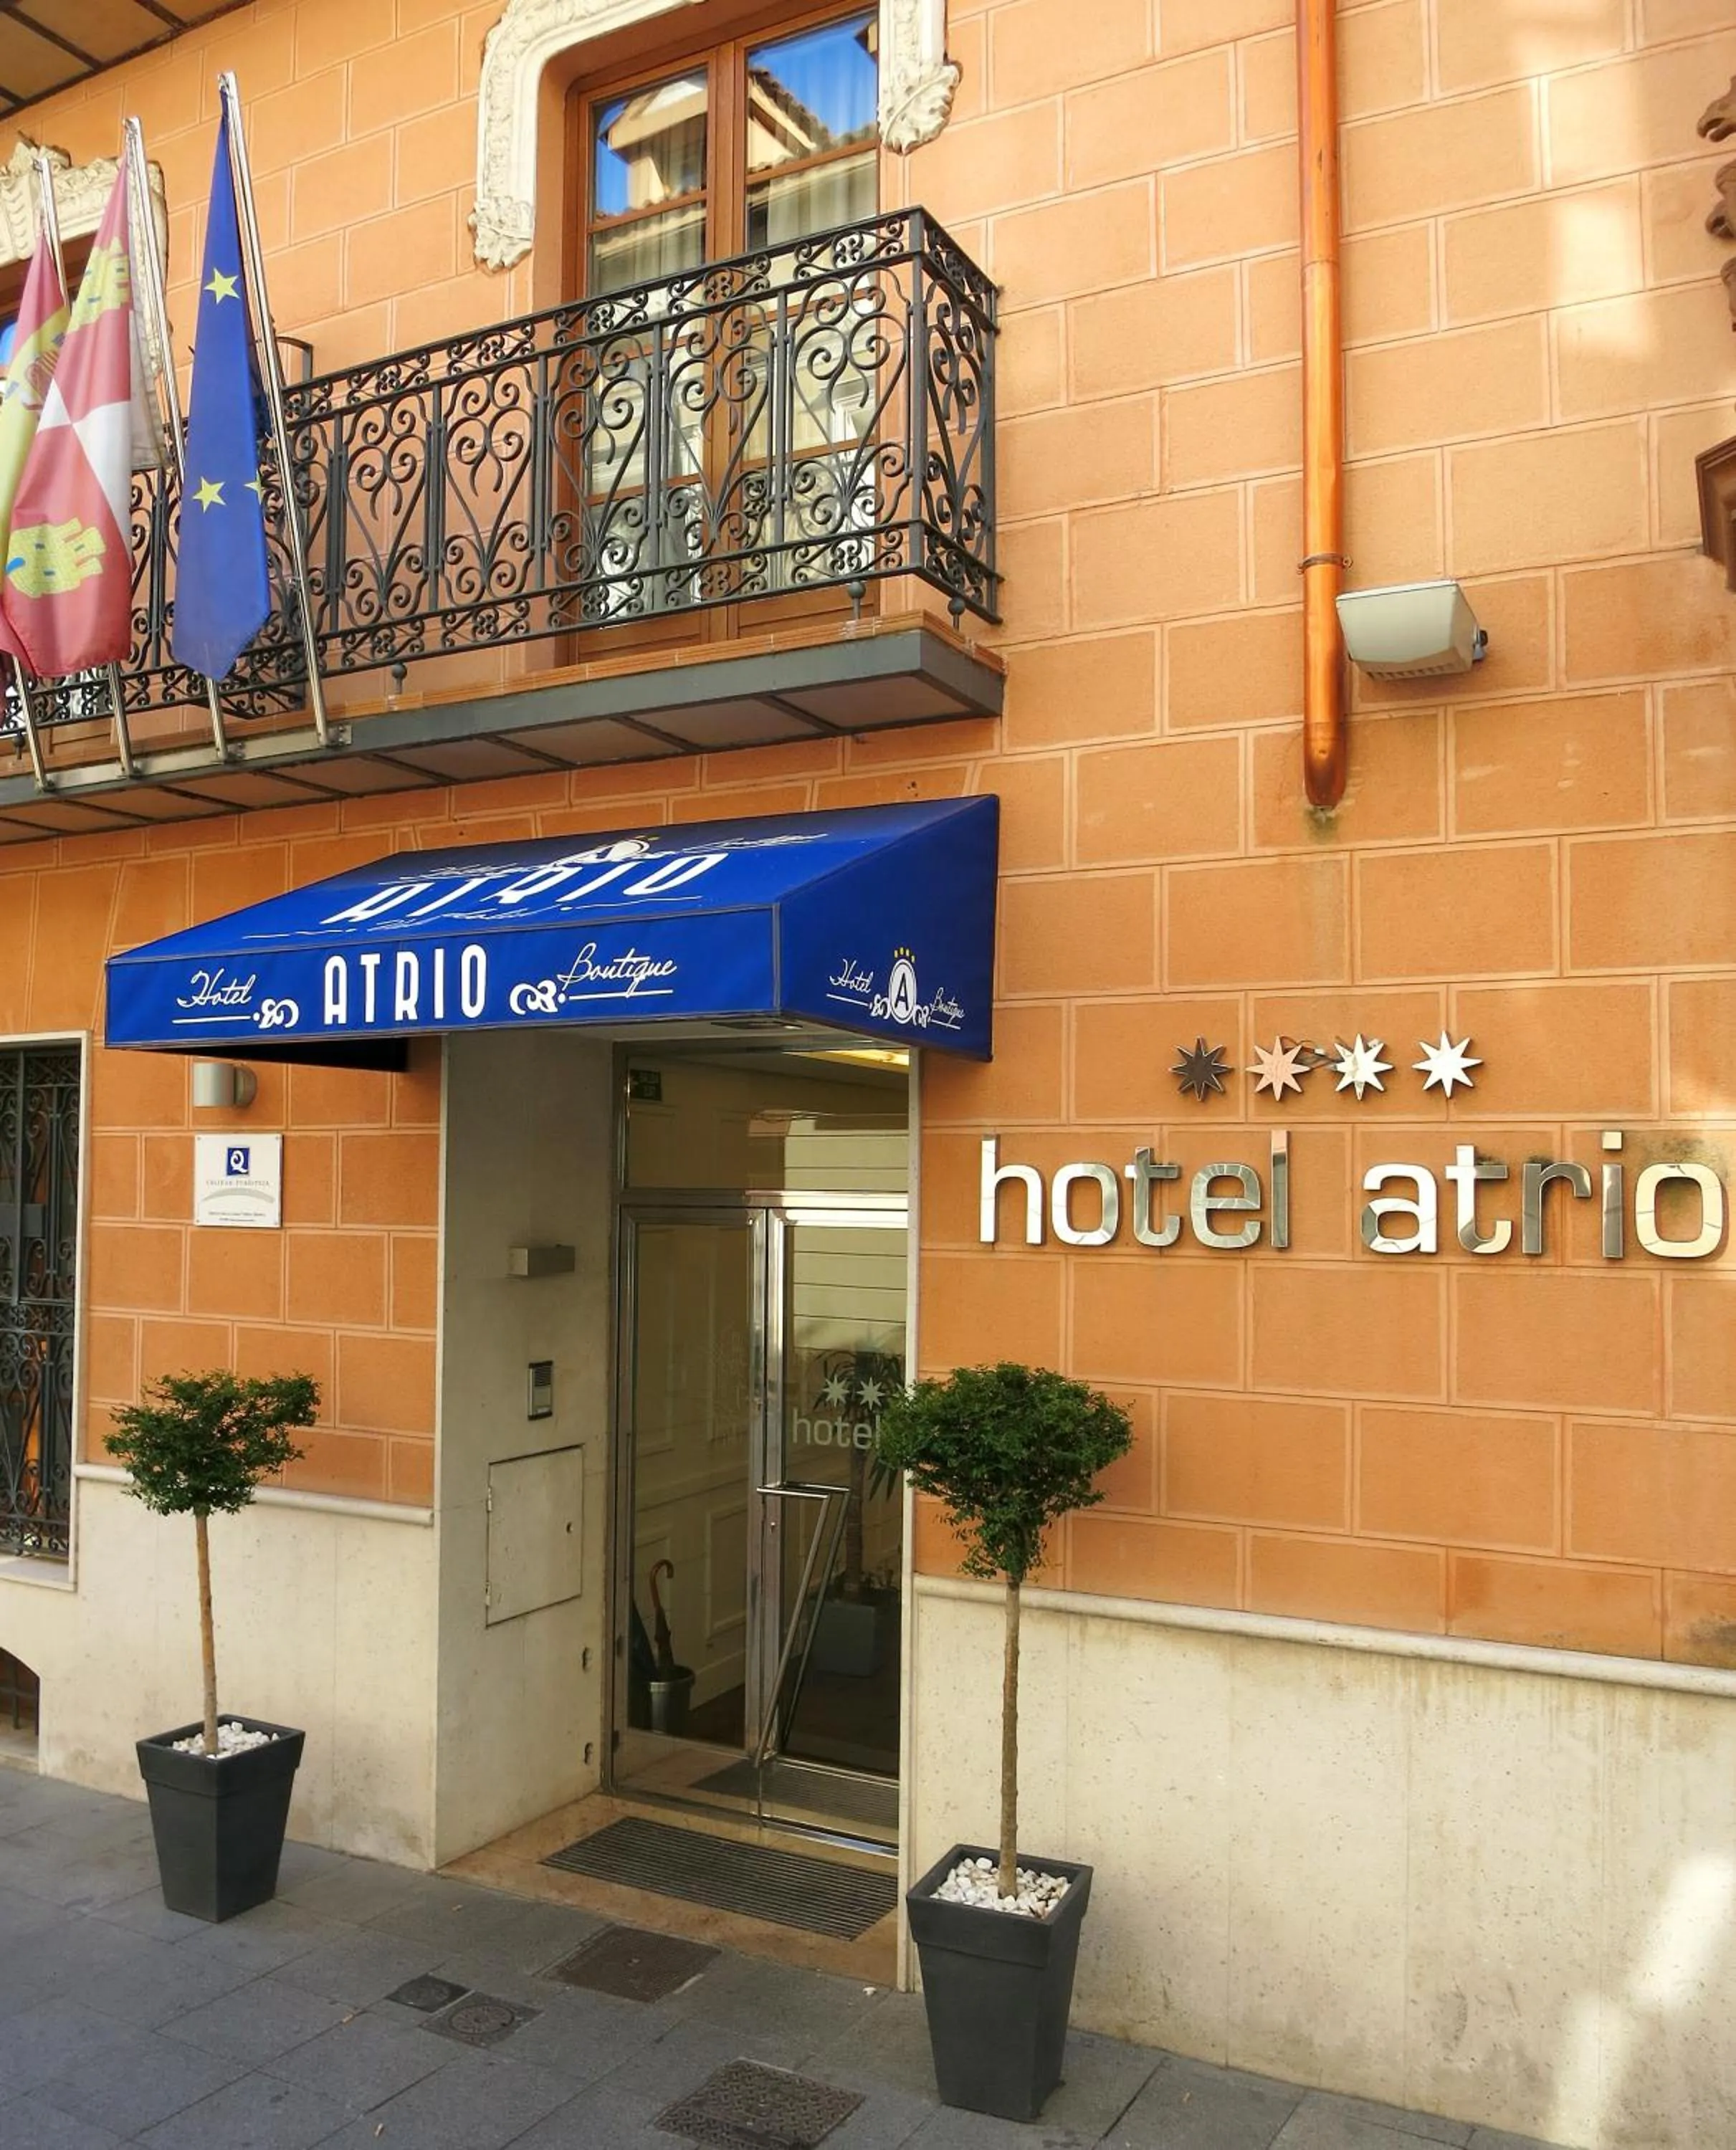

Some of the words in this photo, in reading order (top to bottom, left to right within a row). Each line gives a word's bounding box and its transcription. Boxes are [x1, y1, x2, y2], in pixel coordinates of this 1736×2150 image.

[177, 968, 256, 1008] Hotel
[324, 944, 487, 1025] ATRIO
[557, 942, 677, 998] Boutique
[829, 958, 874, 993] Hotel
[230, 1150, 248, 1173] Q
[980, 1130, 1291, 1249] hotel
[1360, 1130, 1725, 1260] atrio
[793, 1408, 880, 1450] hotel
